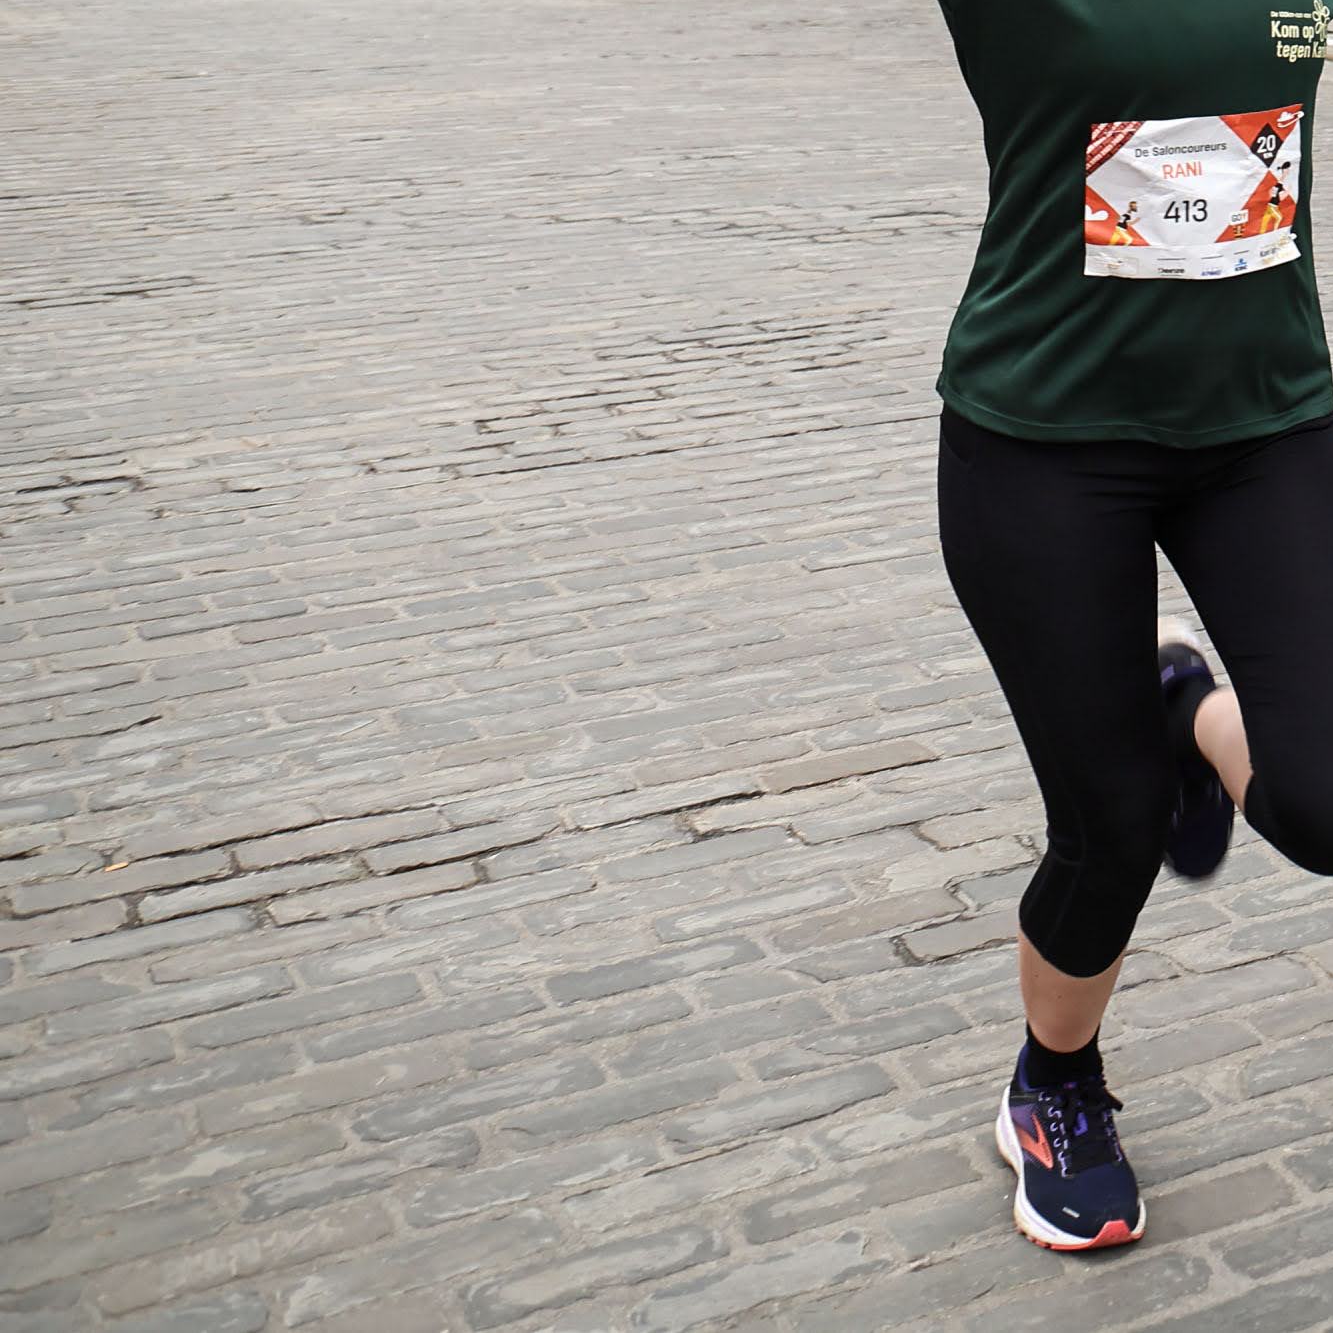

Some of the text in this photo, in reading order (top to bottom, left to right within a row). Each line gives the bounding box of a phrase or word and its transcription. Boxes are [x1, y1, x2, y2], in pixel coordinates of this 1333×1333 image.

[1271, 20, 1315, 43] Kom op
[1276, 40, 1311, 62] tegen
[1134, 141, 1228, 158] De Saloncoureurs
[1257, 134, 1277, 154] 20
[1162, 161, 1203, 181] RANI
[1163, 198, 1208, 224] 413
